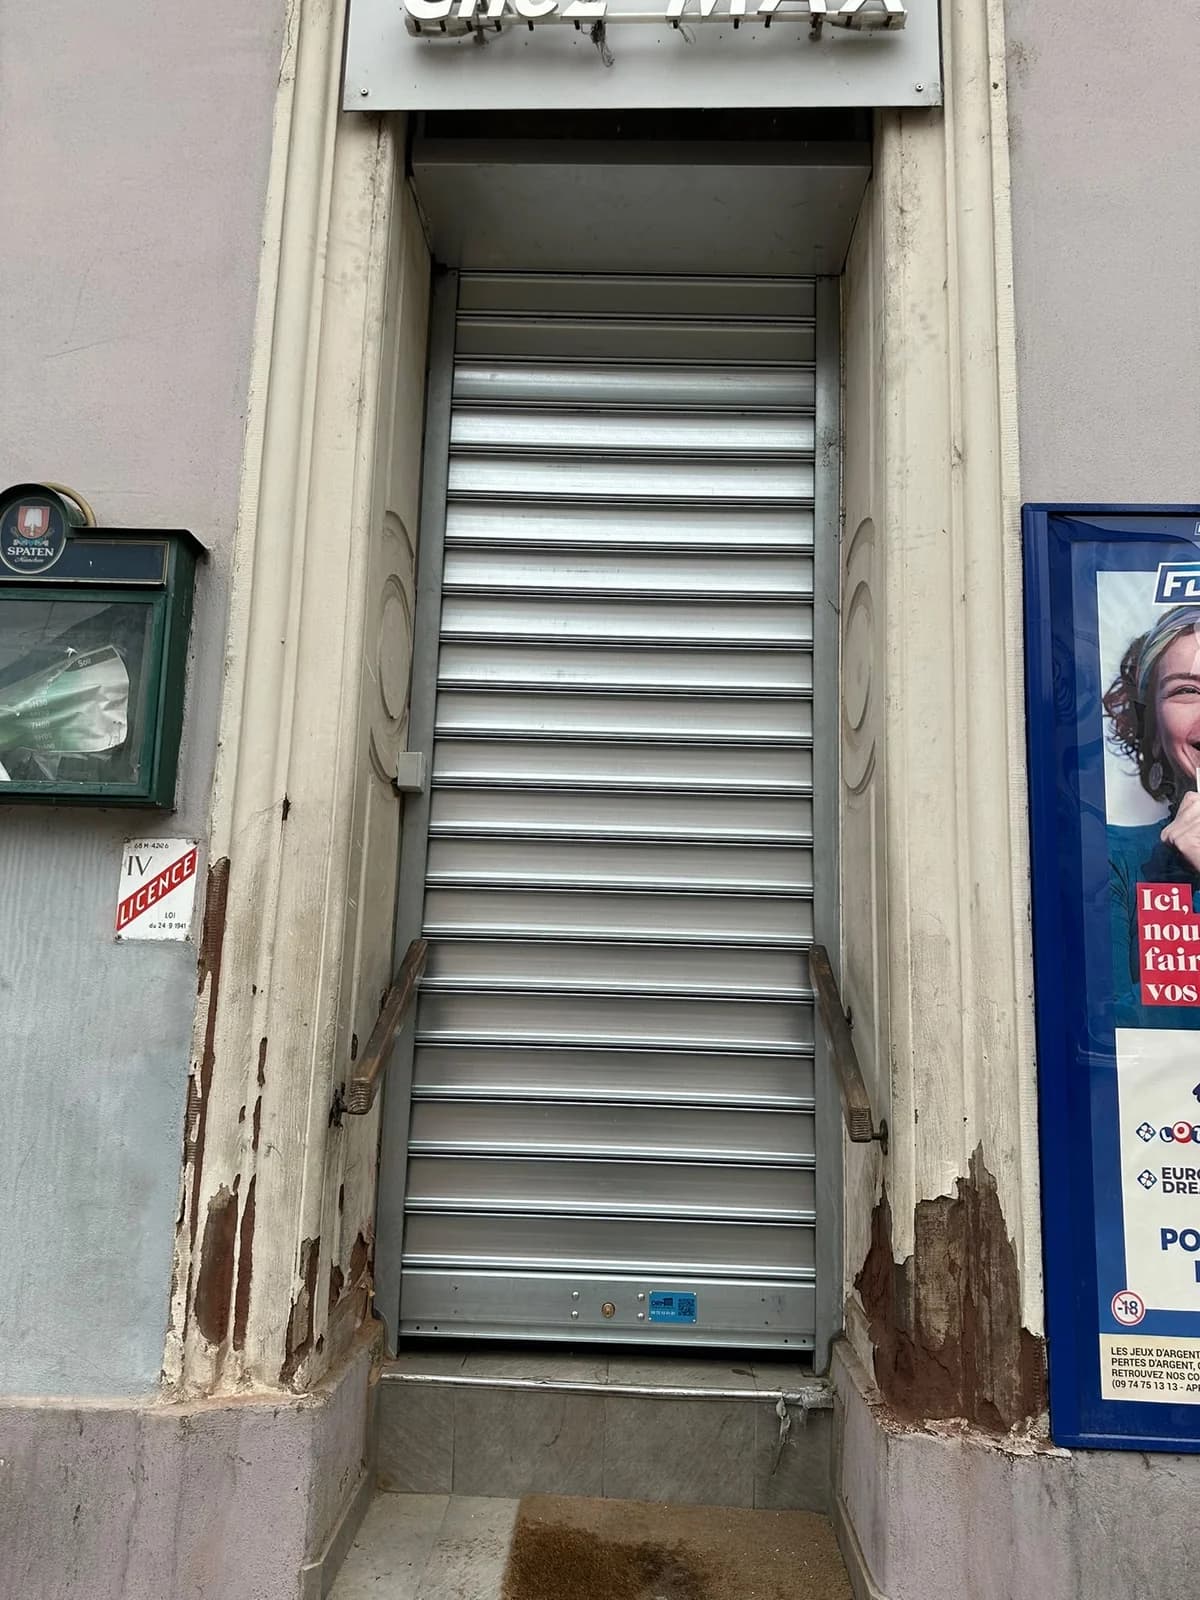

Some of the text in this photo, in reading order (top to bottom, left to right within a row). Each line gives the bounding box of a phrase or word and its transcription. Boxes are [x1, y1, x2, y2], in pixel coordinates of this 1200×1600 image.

[7, 546, 54, 556] SPATEN
[128, 856, 152, 876] IV
[120, 853, 193, 926] LICENCE
[1141, 887, 1189, 915] Ici,
[164, 911, 176, 919] LOI
[1146, 983, 1198, 1002] vos
[1161, 1167, 1200, 1180] EUR
[1162, 1181, 1200, 1194] DRE
[1160, 1228, 1200, 1252] PO
[1117, 1300, 1138, 1315] -18
[1111, 1347, 1200, 1359] LES JEUX D'ARGENT
[1111, 1357, 1146, 1367] PERTES
[1148, 1358, 1196, 1371] D'ARGENT,
[1111, 1369, 1164, 1379] RETROUVEZ
[1166, 1371, 1186, 1381] NOS
[1112, 1379, 1126, 1389] (09
[1128, 1380, 1138, 1388] 74
[1140, 1381, 1151, 1389] 75
[1154, 1381, 1165, 1390] 13
[1167, 1382, 1178, 1391] 13
